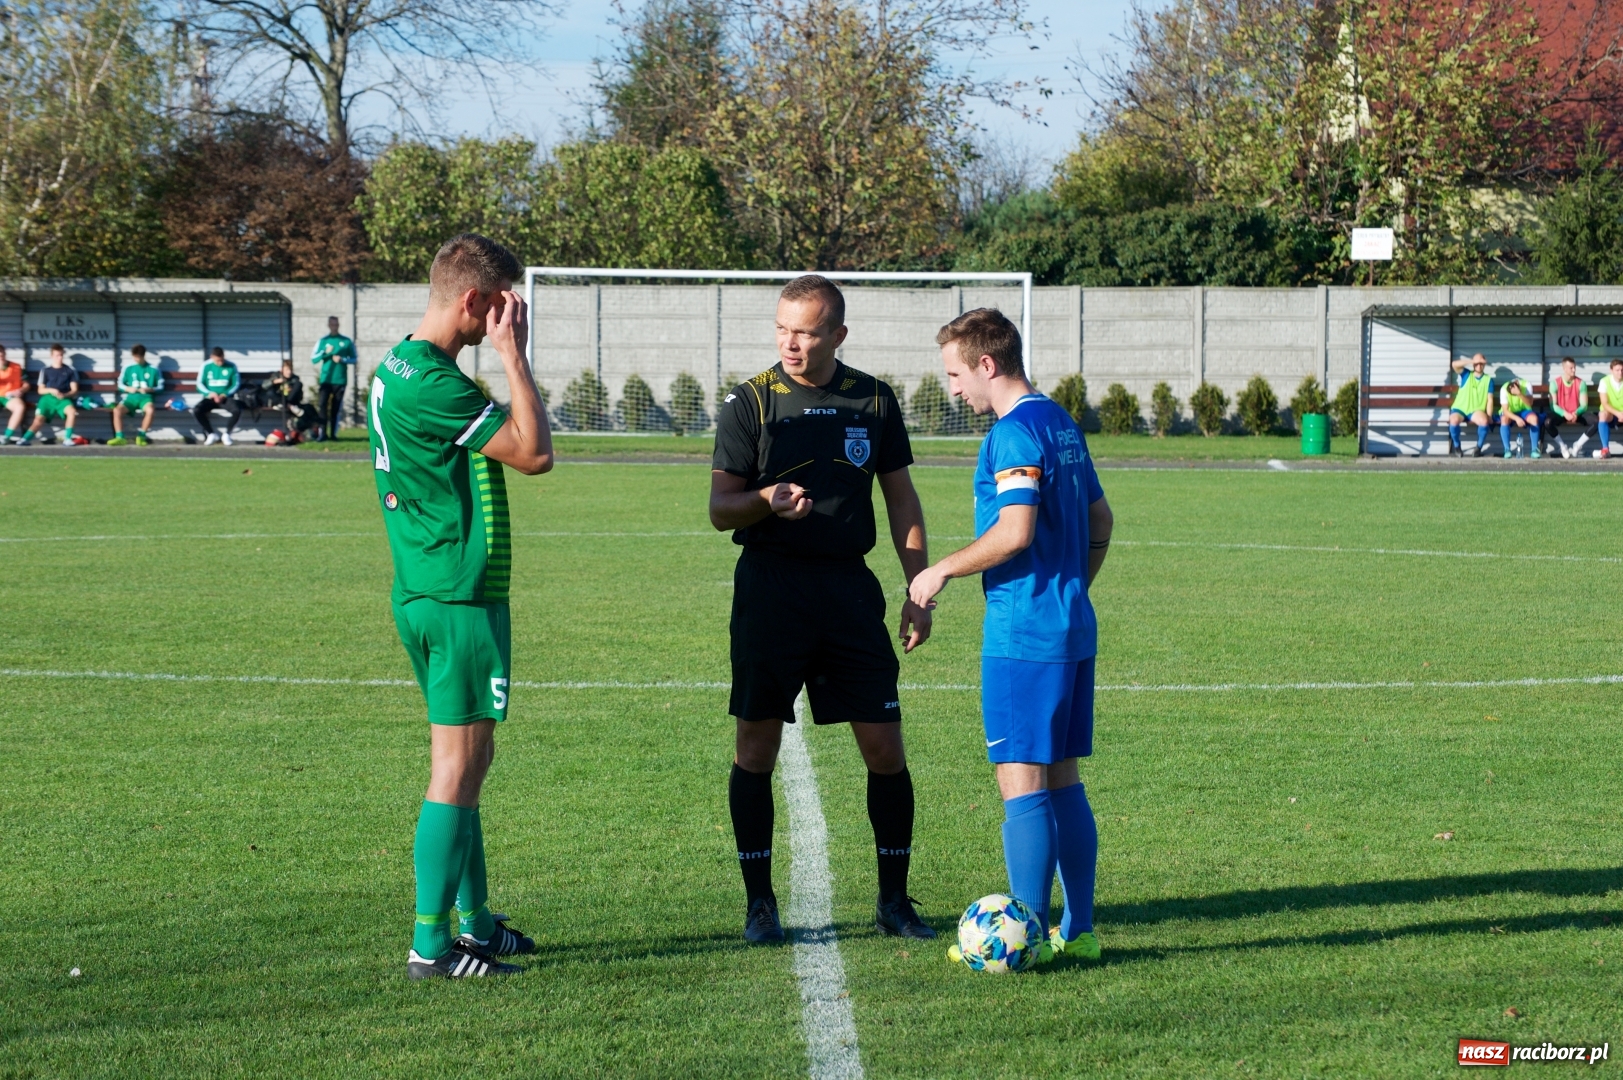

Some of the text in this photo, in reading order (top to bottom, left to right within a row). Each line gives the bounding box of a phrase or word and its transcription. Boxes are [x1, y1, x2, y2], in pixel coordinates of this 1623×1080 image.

[56, 315, 85, 327] LKS
[27, 326, 111, 341] TWORKÓW
[1558, 331, 1623, 348] GOŚCIE
[491, 677, 507, 710] 5
